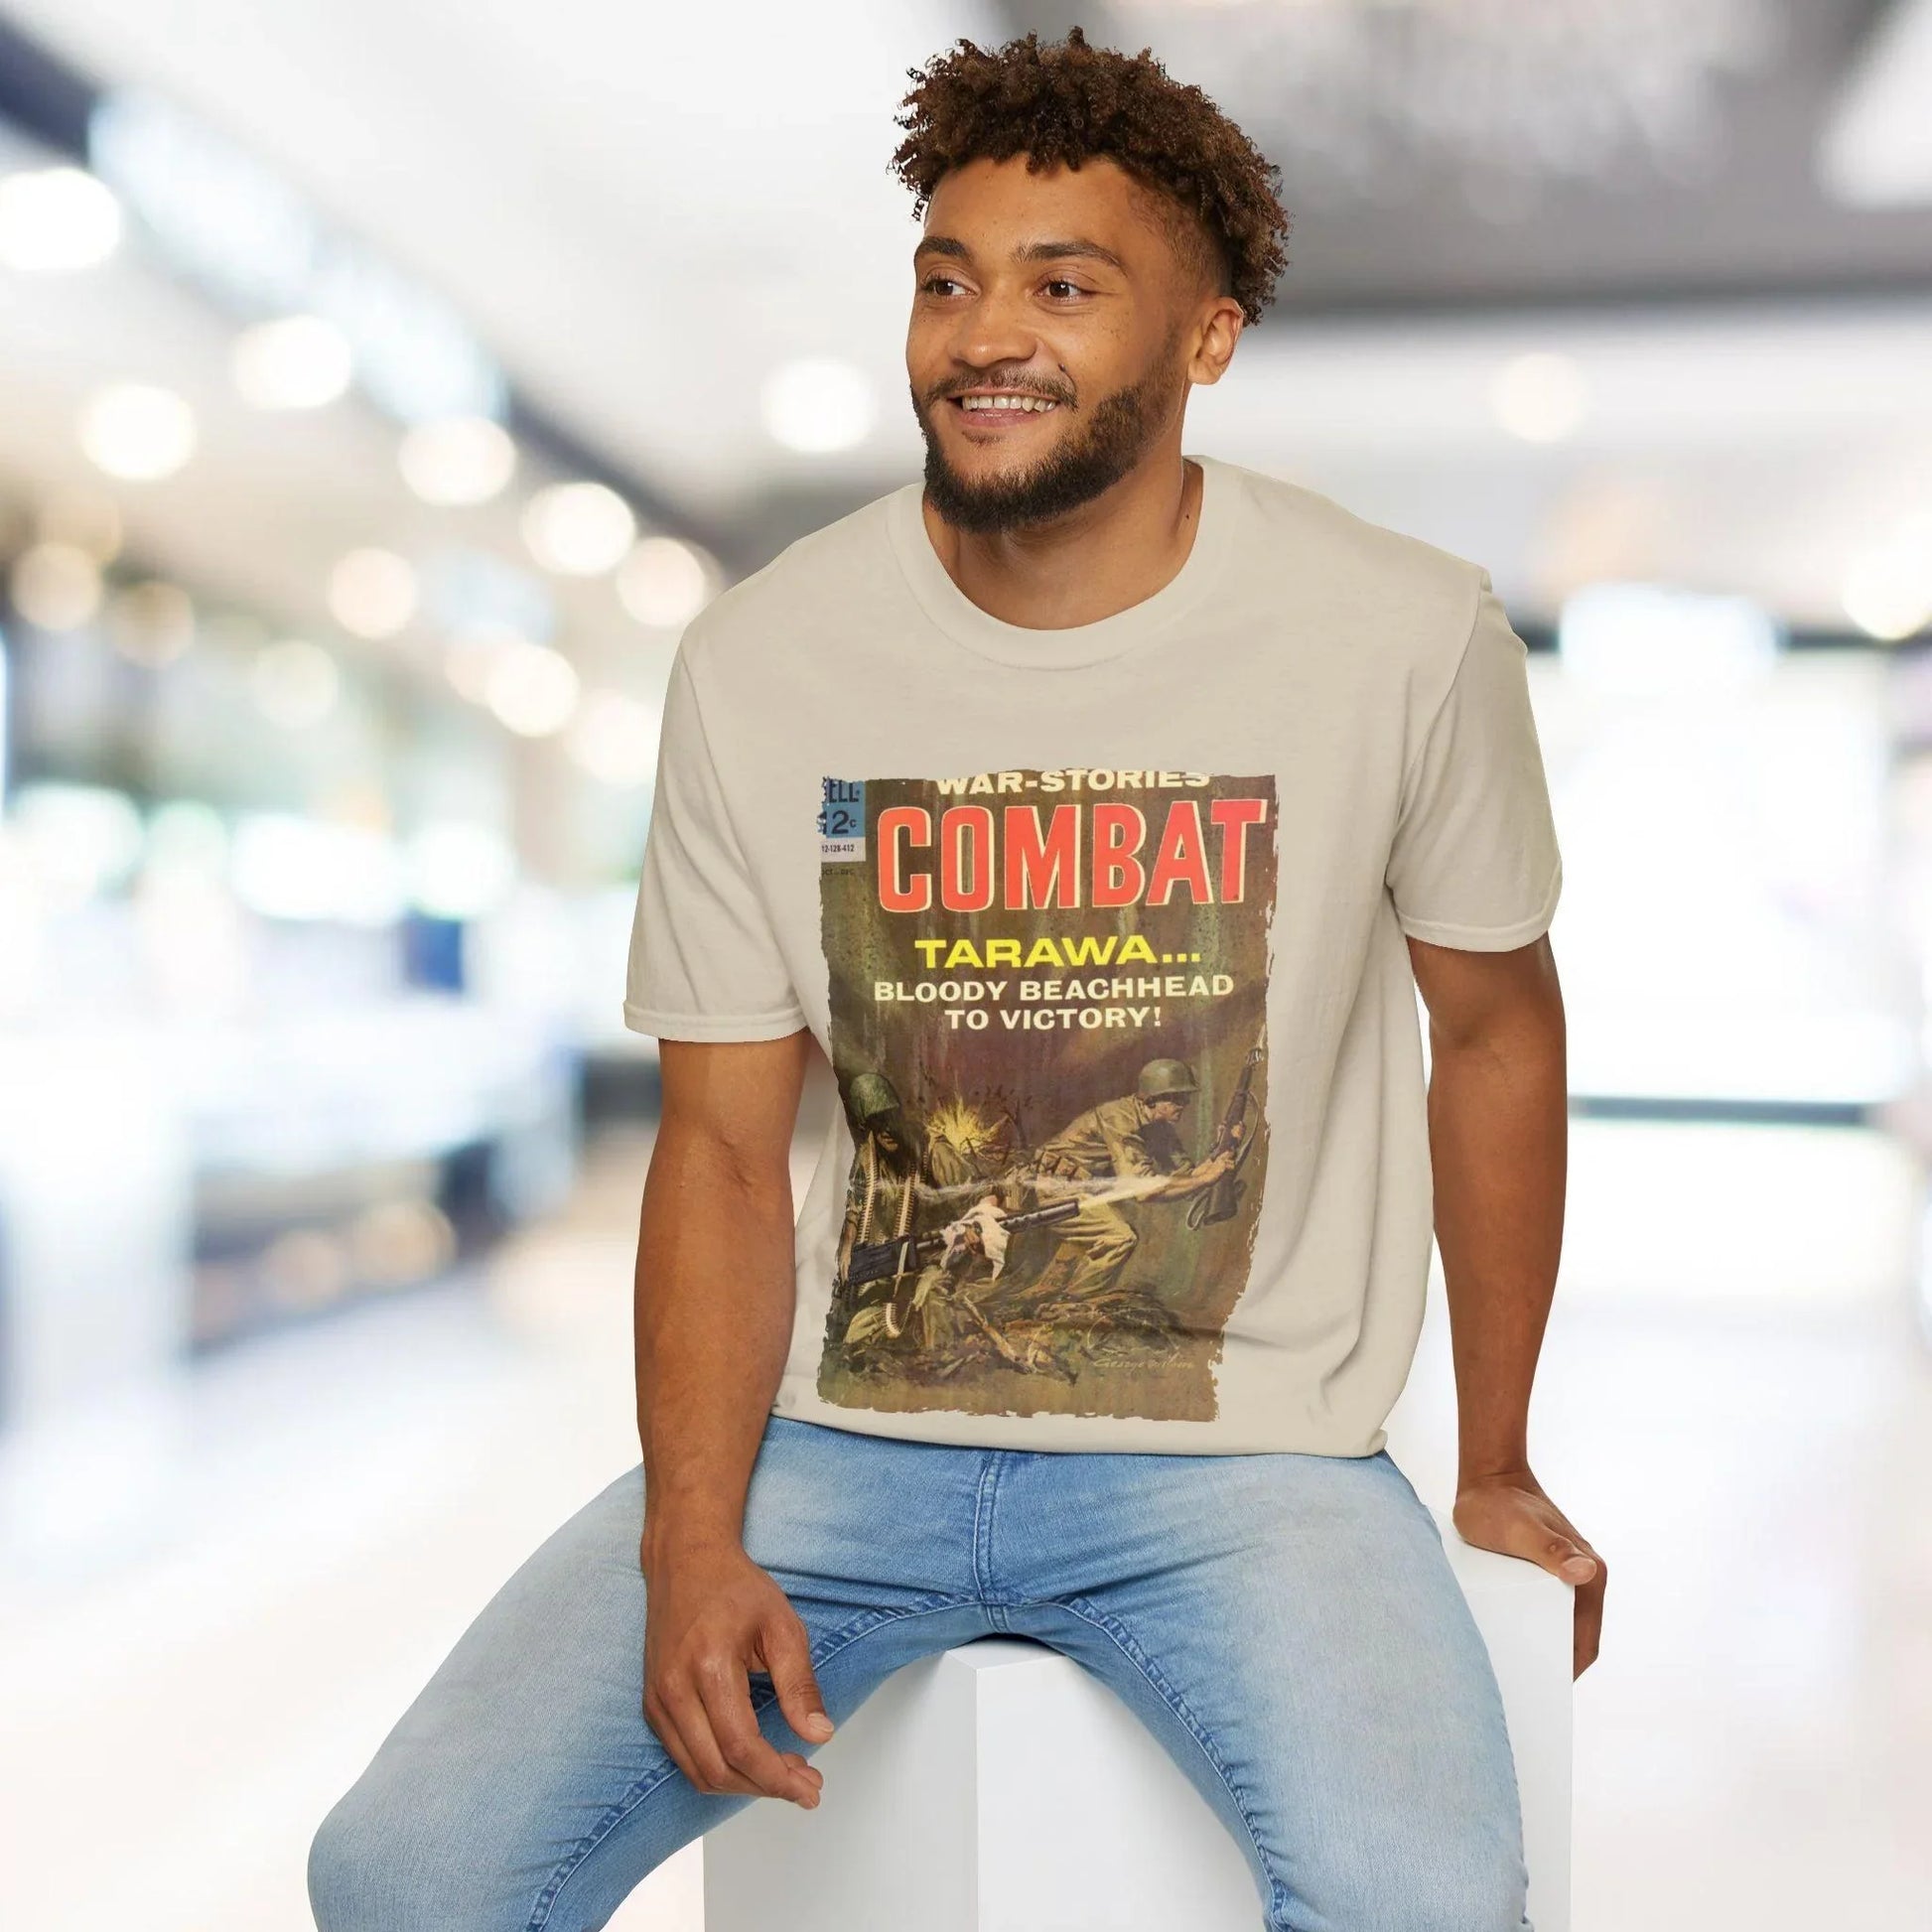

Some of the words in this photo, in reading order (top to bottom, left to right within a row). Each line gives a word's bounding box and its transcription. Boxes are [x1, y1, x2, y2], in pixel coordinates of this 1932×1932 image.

[877, 798, 1268, 913] COMBAT
[914, 934, 1201, 969] TARAWA...
[874, 981, 1008, 1003] BLOODY
[1019, 974, 1235, 1002] BEACHHEAD
[944, 1009, 989, 1031] TO
[1000, 1006, 1162, 1031] VICTORY!
